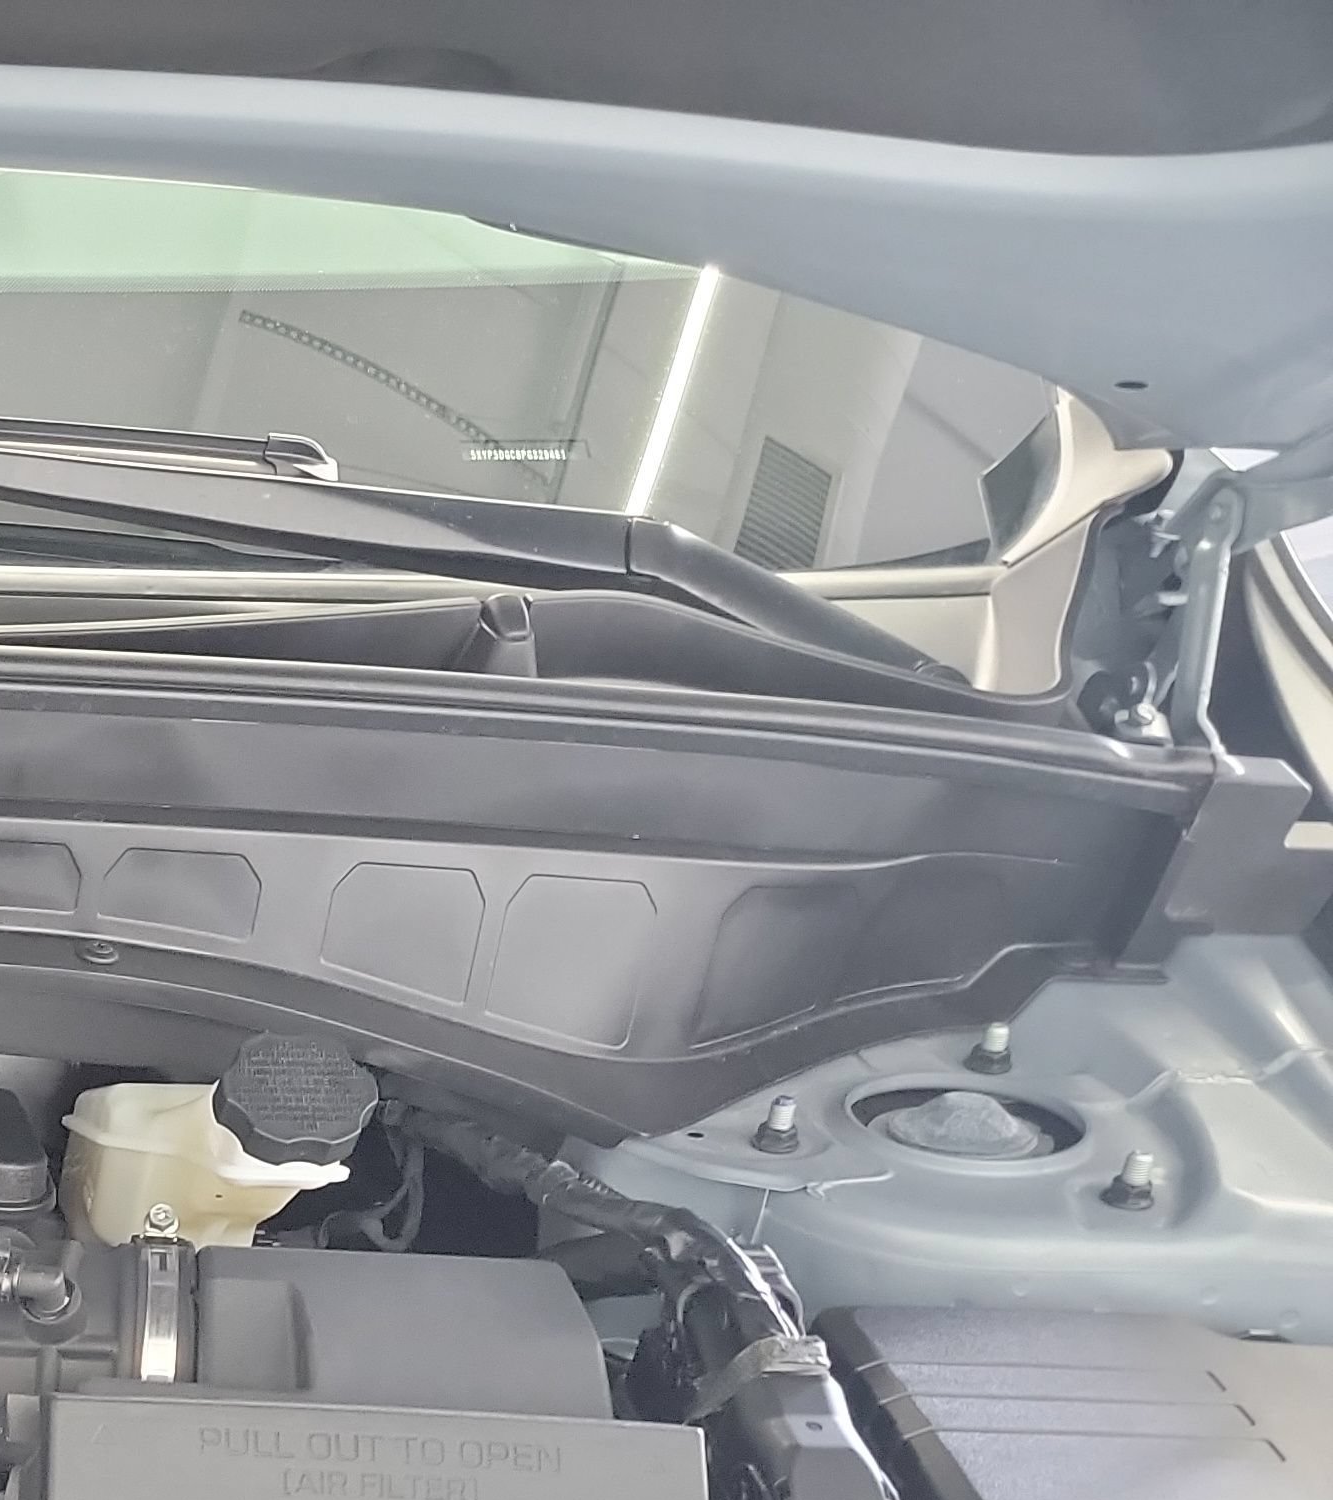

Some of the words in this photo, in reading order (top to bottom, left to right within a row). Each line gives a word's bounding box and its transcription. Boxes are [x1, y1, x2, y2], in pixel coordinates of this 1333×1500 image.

[198, 1426, 295, 1460] PULL
[307, 1432, 381, 1463] OUT
[393, 1436, 445, 1467] TO
[460, 1440, 561, 1472] OPEN
